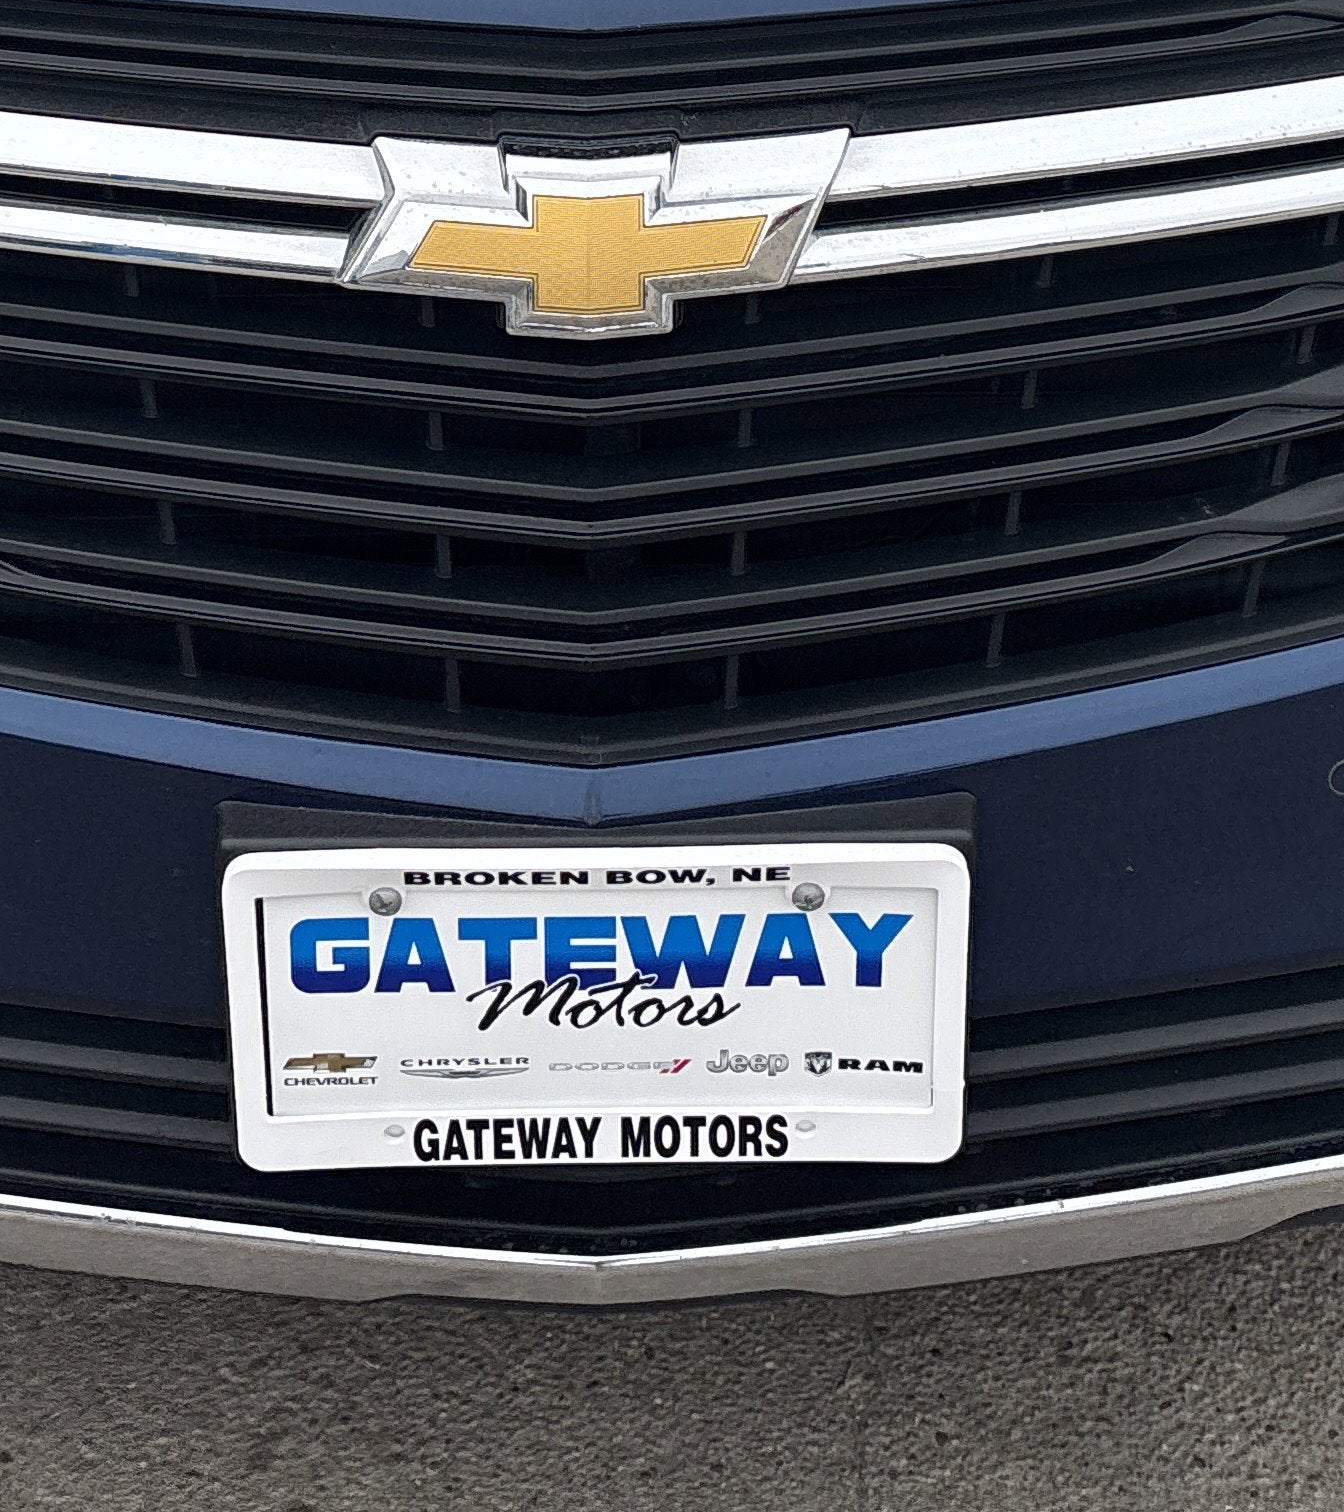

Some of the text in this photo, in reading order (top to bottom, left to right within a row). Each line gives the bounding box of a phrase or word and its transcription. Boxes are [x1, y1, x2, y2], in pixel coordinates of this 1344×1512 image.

[402, 866, 792, 887] BROKEN BOW, NE
[289, 912, 914, 995] GATEWAY
[466, 970, 743, 1032] Motors
[399, 1056, 530, 1068] CHRYSLER
[705, 1049, 790, 1076] Jeep
[837, 1057, 923, 1074] RAM
[283, 1075, 379, 1087] CHEVROLET
[412, 1115, 789, 1162] GATEWAY MOTORS
